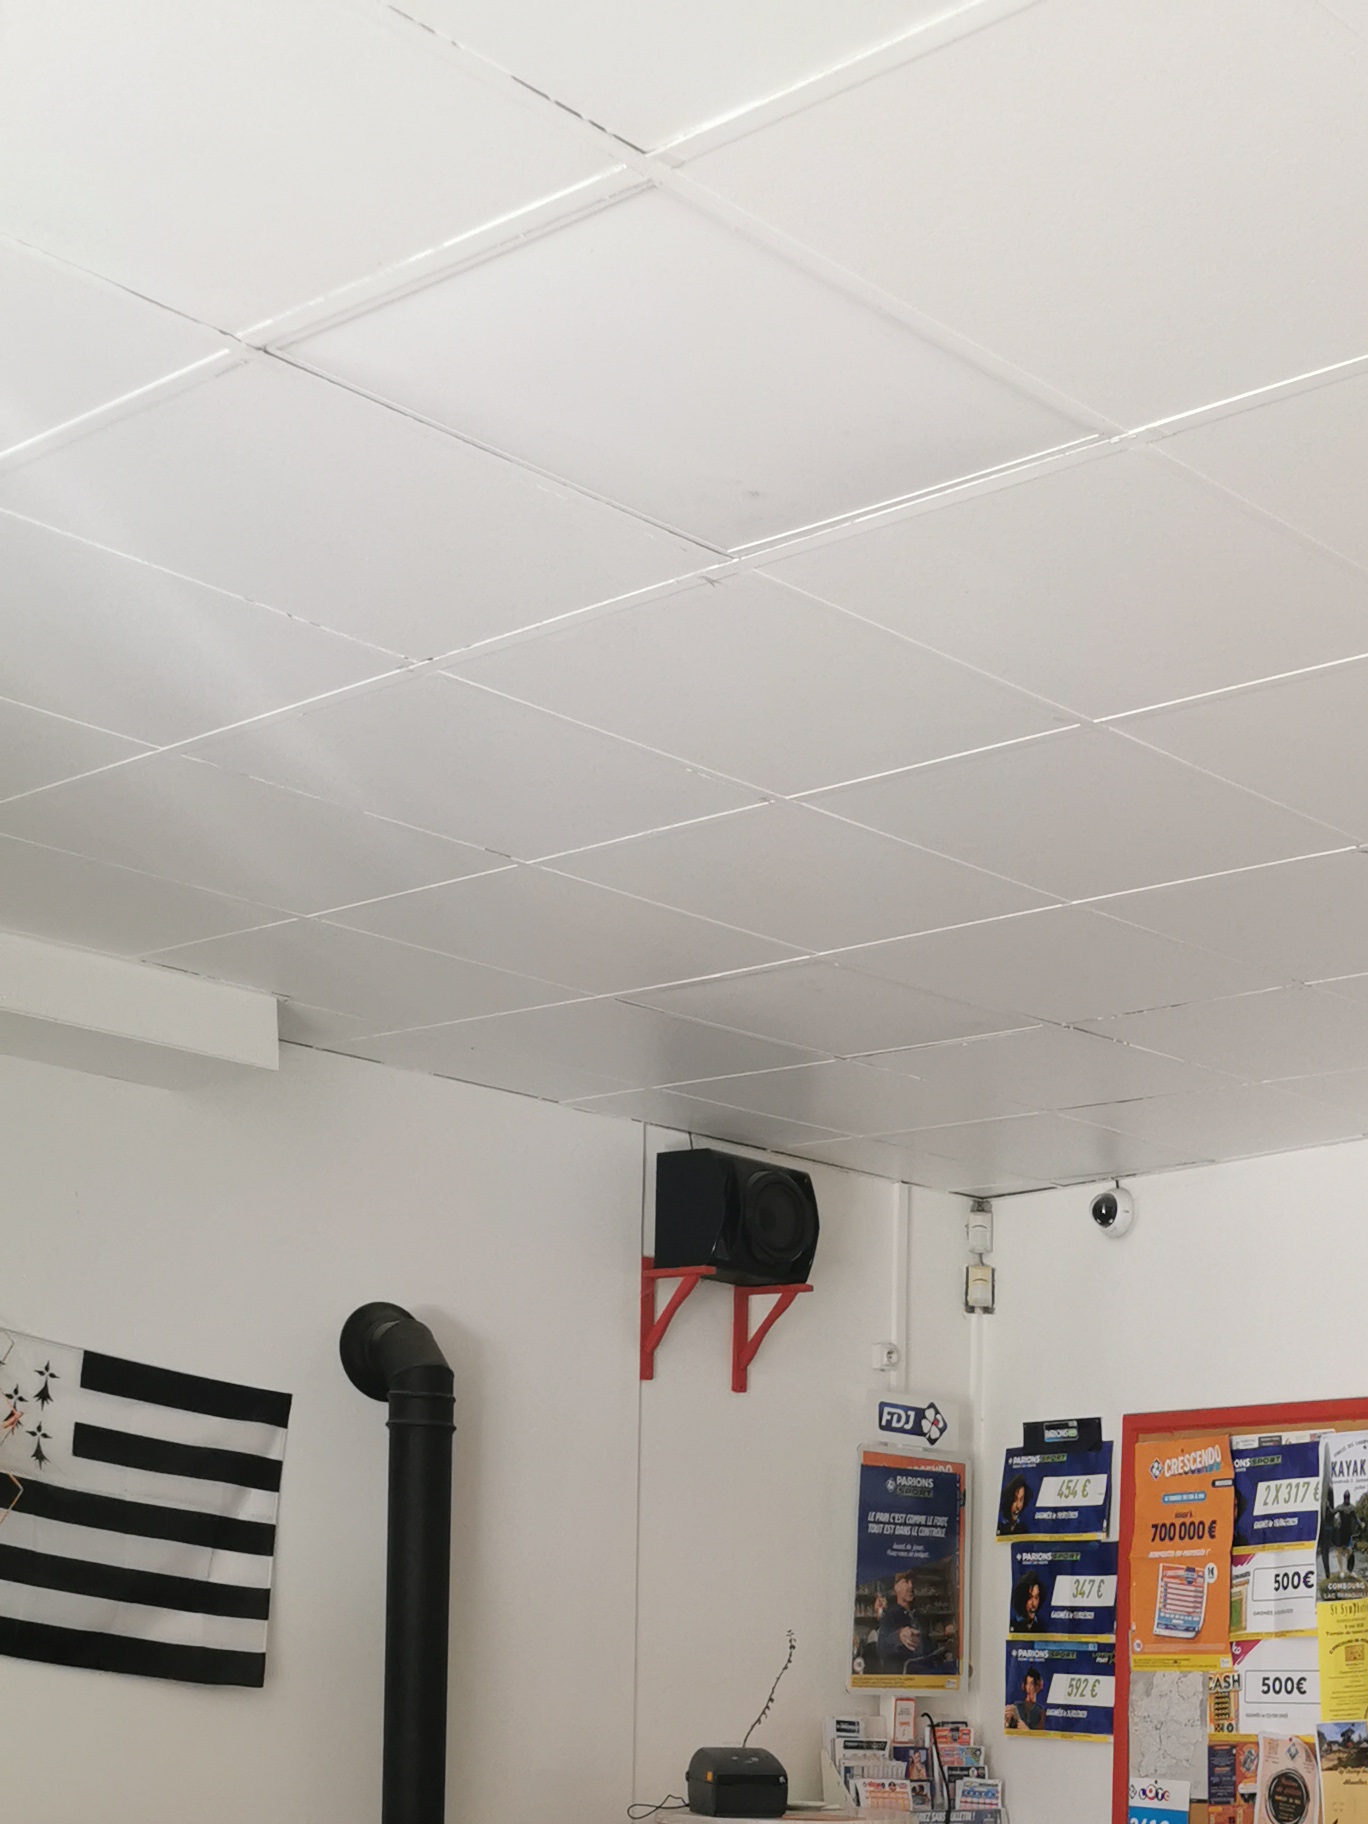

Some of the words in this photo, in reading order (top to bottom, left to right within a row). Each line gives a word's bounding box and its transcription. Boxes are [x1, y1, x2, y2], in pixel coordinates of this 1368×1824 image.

[881, 1407, 915, 1430] FDJ
[1013, 1455, 1040, 1464] PARIONS
[1164, 1444, 1222, 1477] CRESCENDO
[1251, 1455, 1282, 1466] SPORT
[1331, 1459, 1366, 1477] KAYAK
[896, 1475, 934, 1488] PARIONS
[1057, 1479, 1079, 1499] 454
[1081, 1478, 1091, 1498] €
[1262, 1485, 1271, 1506] 2
[1284, 1481, 1311, 1504] 317
[1151, 1522, 1177, 1543] 700
[1178, 1521, 1206, 1541] 000
[1208, 1520, 1217, 1539] €
[1022, 1552, 1052, 1561] PARIONS
[1072, 1579, 1095, 1598] 347
[1097, 1579, 1105, 1599] €
[1274, 1571, 1314, 1591] 500€
[1327, 1582, 1365, 1590] COMBOURG
[1018, 1649, 1048, 1659] PARIONS
[1067, 1678, 1089, 1698] 592
[1090, 1679, 1100, 1698] €
[1261, 1677, 1307, 1695] 500€
[1139, 1784, 1170, 1801] LOTO
